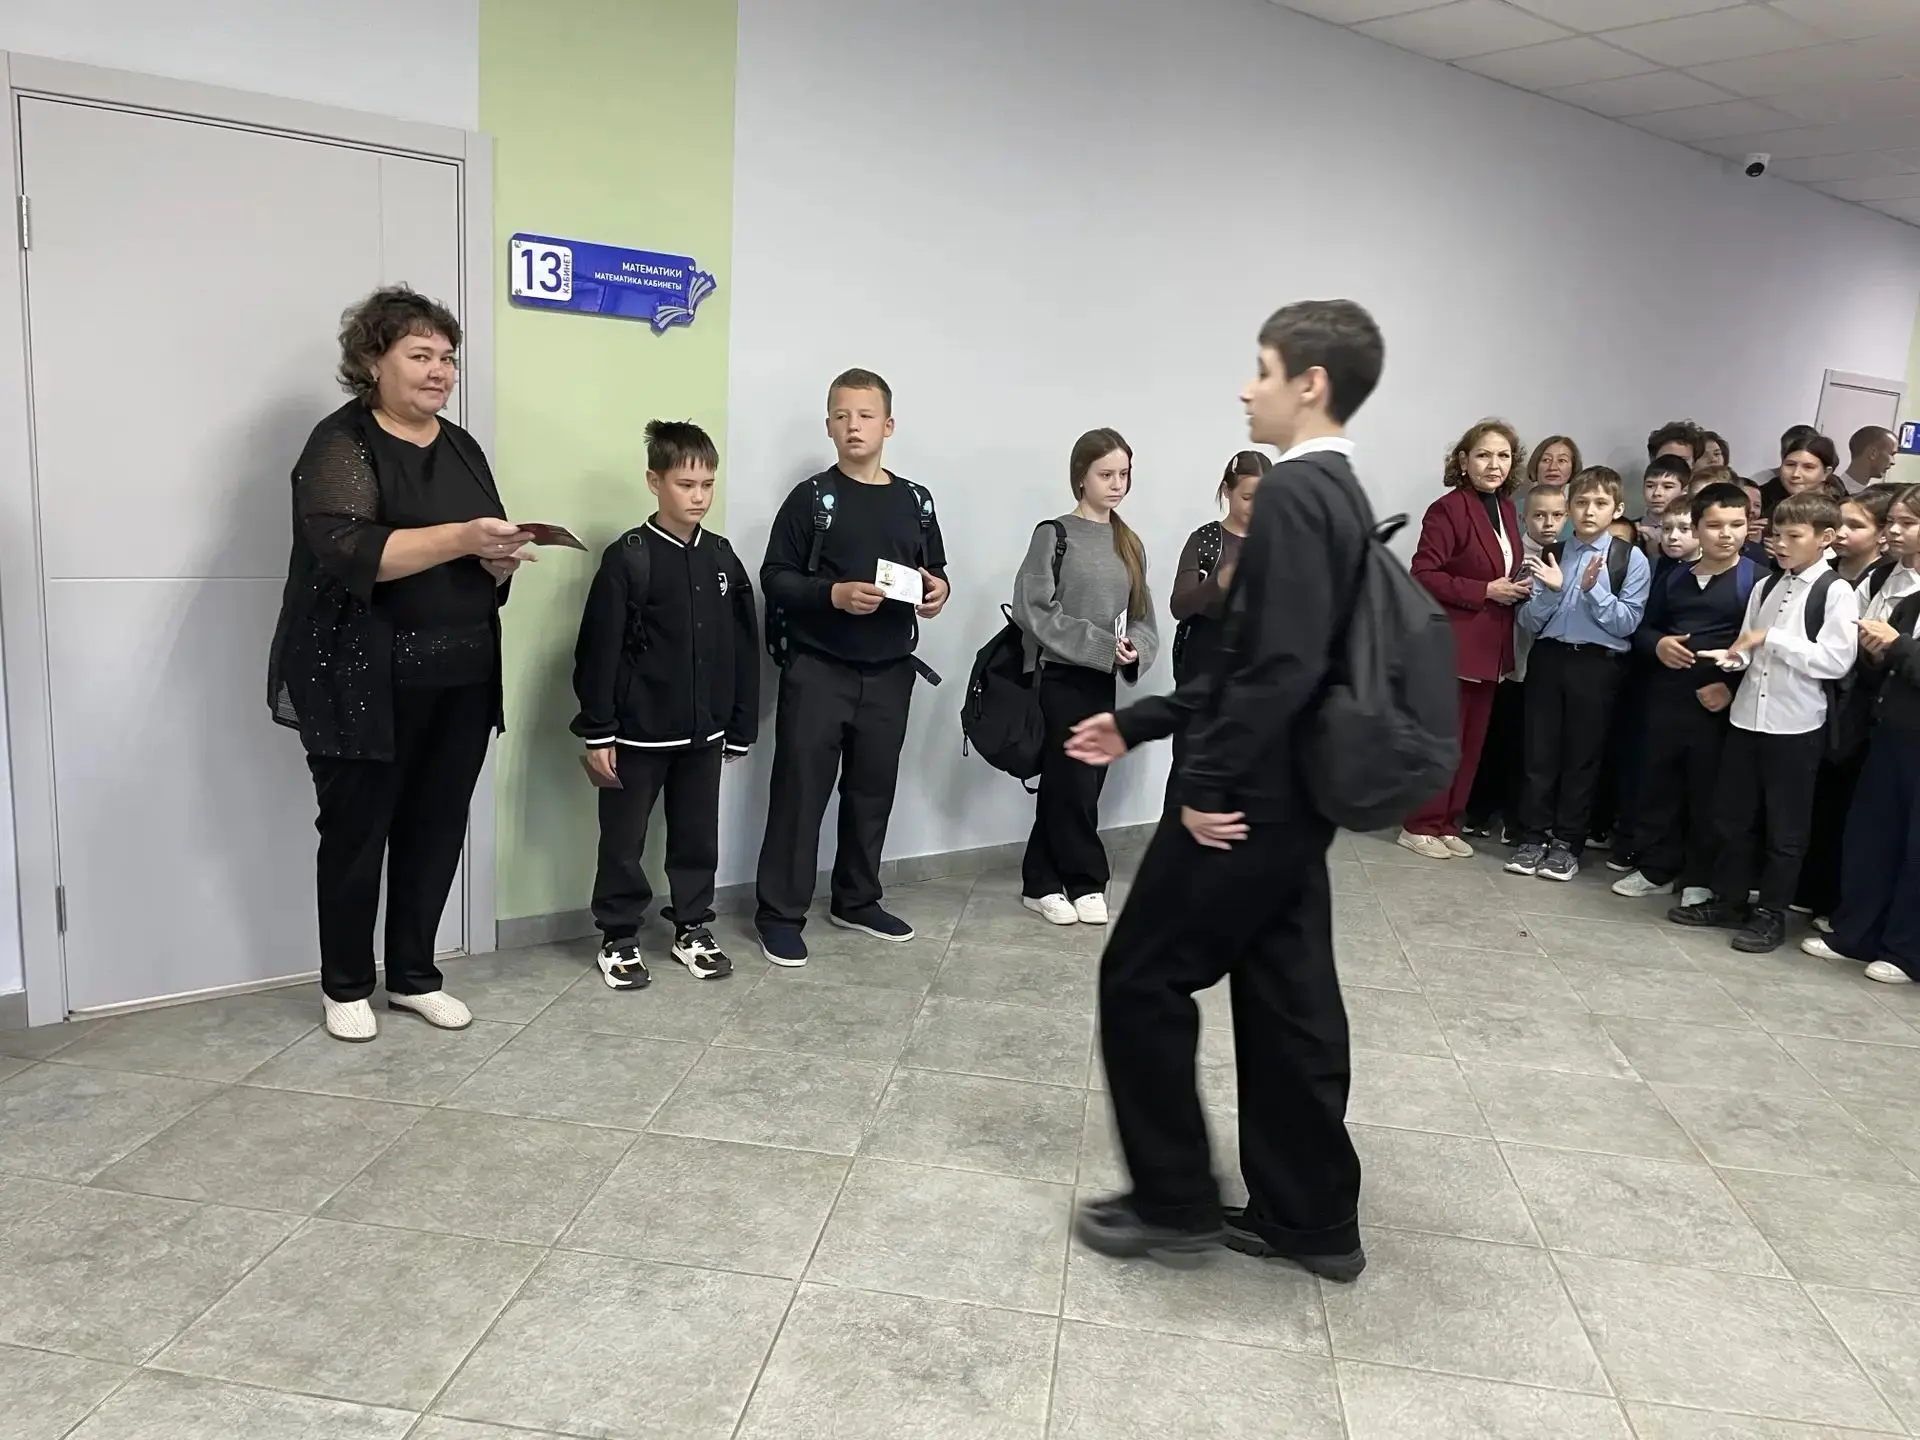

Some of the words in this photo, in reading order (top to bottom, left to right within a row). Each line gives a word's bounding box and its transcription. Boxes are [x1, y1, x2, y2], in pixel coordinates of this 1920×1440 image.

[521, 249, 562, 292] 13
[562, 253, 570, 294] КАБИНЕТ
[594, 272, 642, 285] МАТЕМАТИКА
[643, 279, 682, 290] КАБИНЕТЫ
[622, 262, 682, 278] МАТЕМАТИКИ
